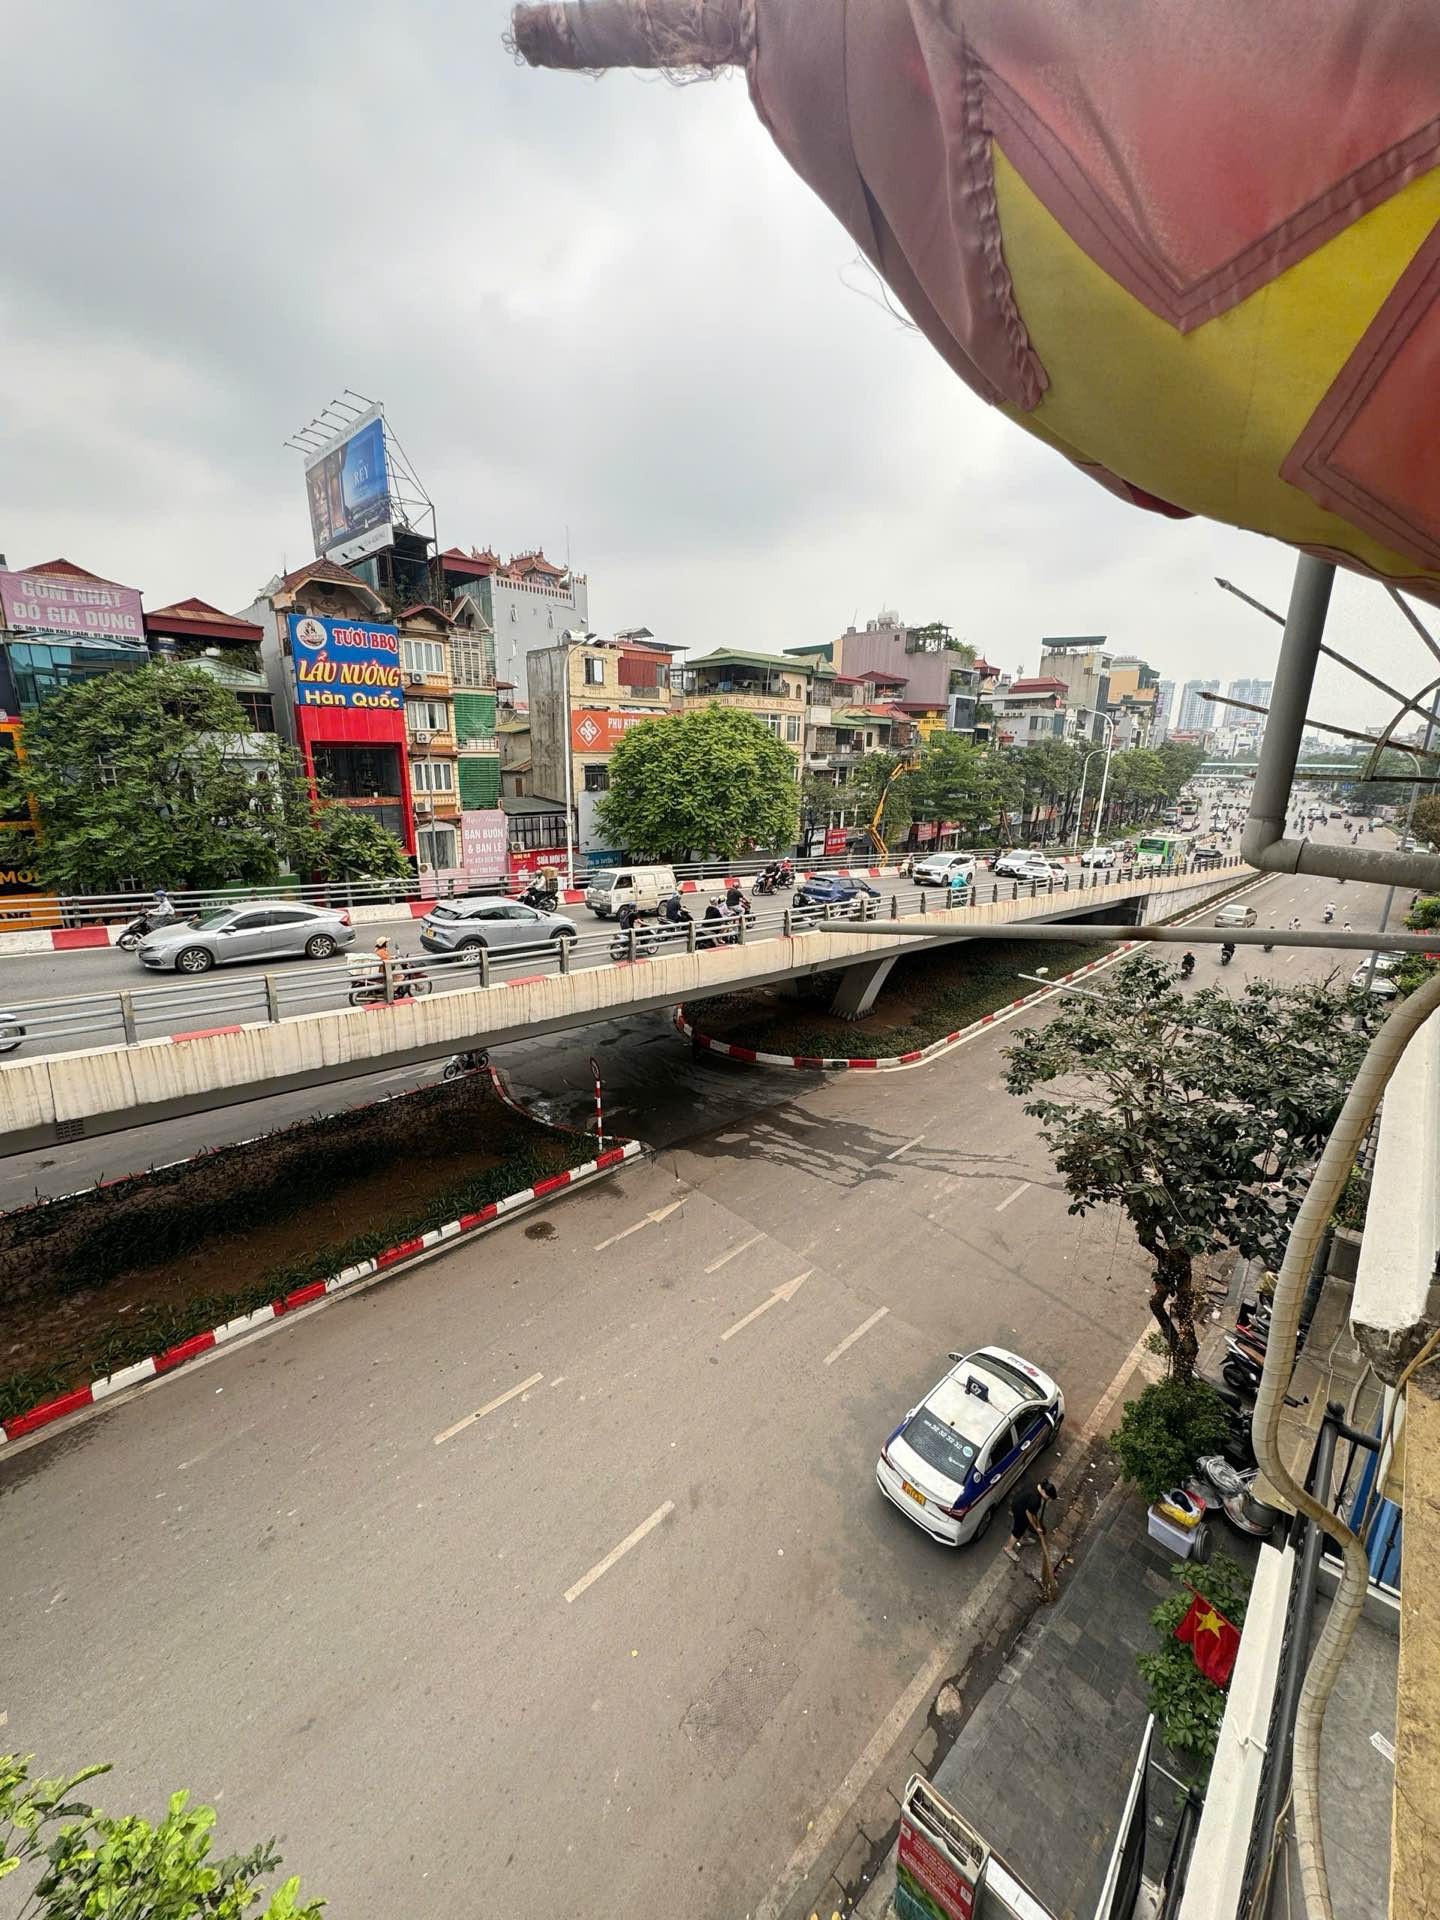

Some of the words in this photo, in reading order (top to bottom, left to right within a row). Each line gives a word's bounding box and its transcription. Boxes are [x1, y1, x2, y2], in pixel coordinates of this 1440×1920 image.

[73, 588, 121, 609] NHẬT
[13, 599, 40, 620] ĐỒ
[47, 606, 80, 624] GIA
[85, 610, 136, 631] DỤNG
[333, 628, 369, 648] TƯƠI
[370, 632, 399, 654] BBQ
[299, 651, 338, 683] LẨU
[340, 659, 401, 687] NƯỚNG
[305, 689, 346, 705] Hàn
[352, 691, 400, 708] Quốc
